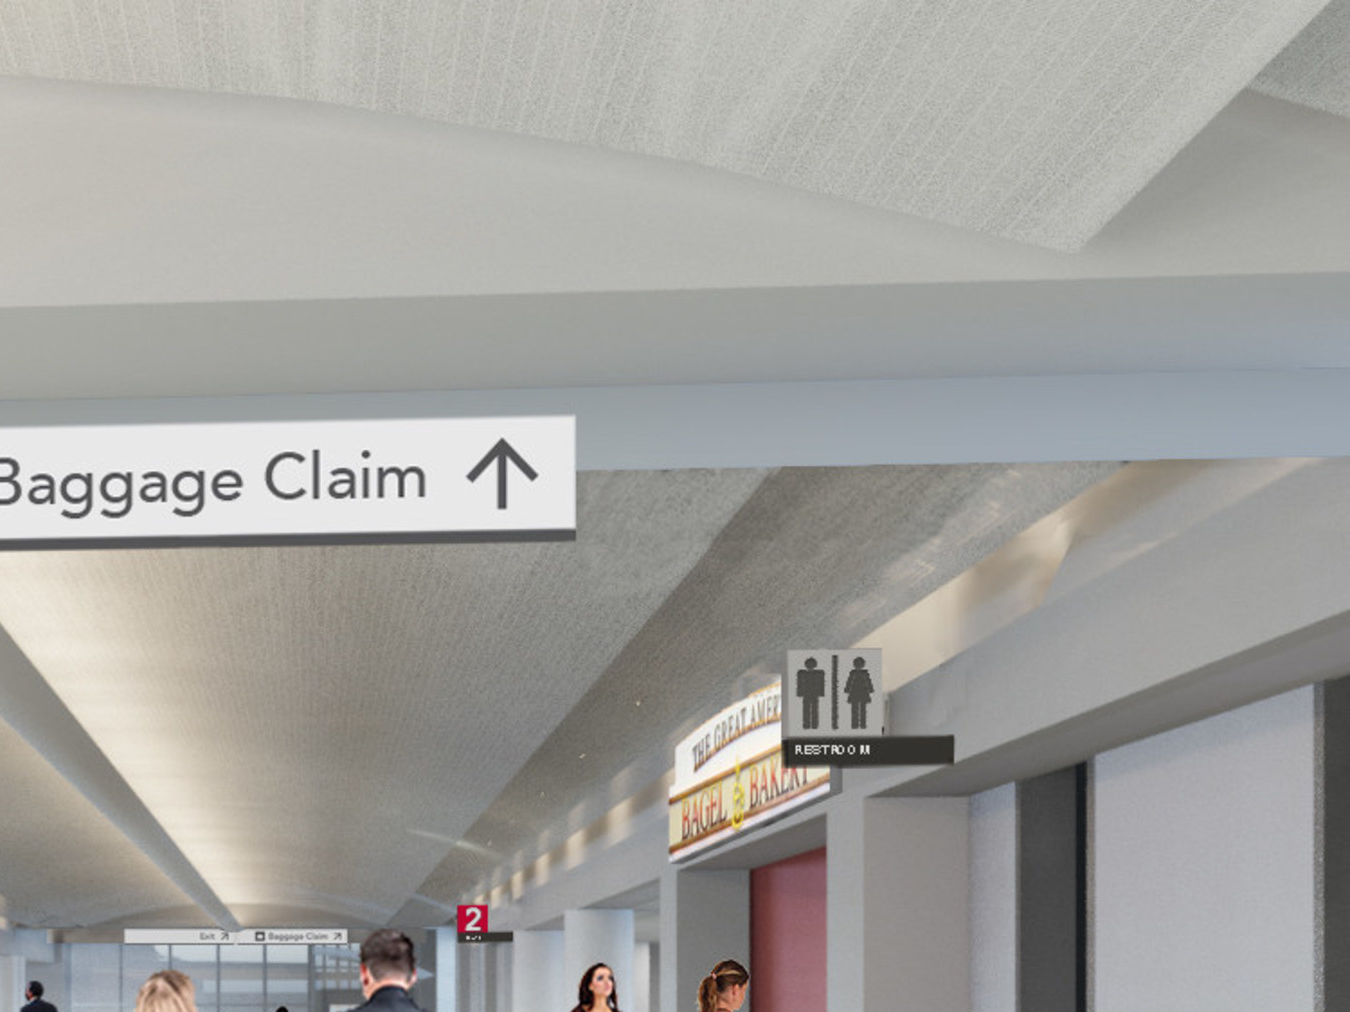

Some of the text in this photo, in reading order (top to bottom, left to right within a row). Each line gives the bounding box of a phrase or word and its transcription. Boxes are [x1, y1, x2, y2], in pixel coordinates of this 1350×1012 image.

[264, 450, 427, 501] Claim
[691, 734, 711, 771] THE
[714, 708, 747, 751] GREAT
[681, 784, 728, 840] BAGEL
[268, 931, 328, 942] Baggage Claim
[465, 907, 482, 931] 2
